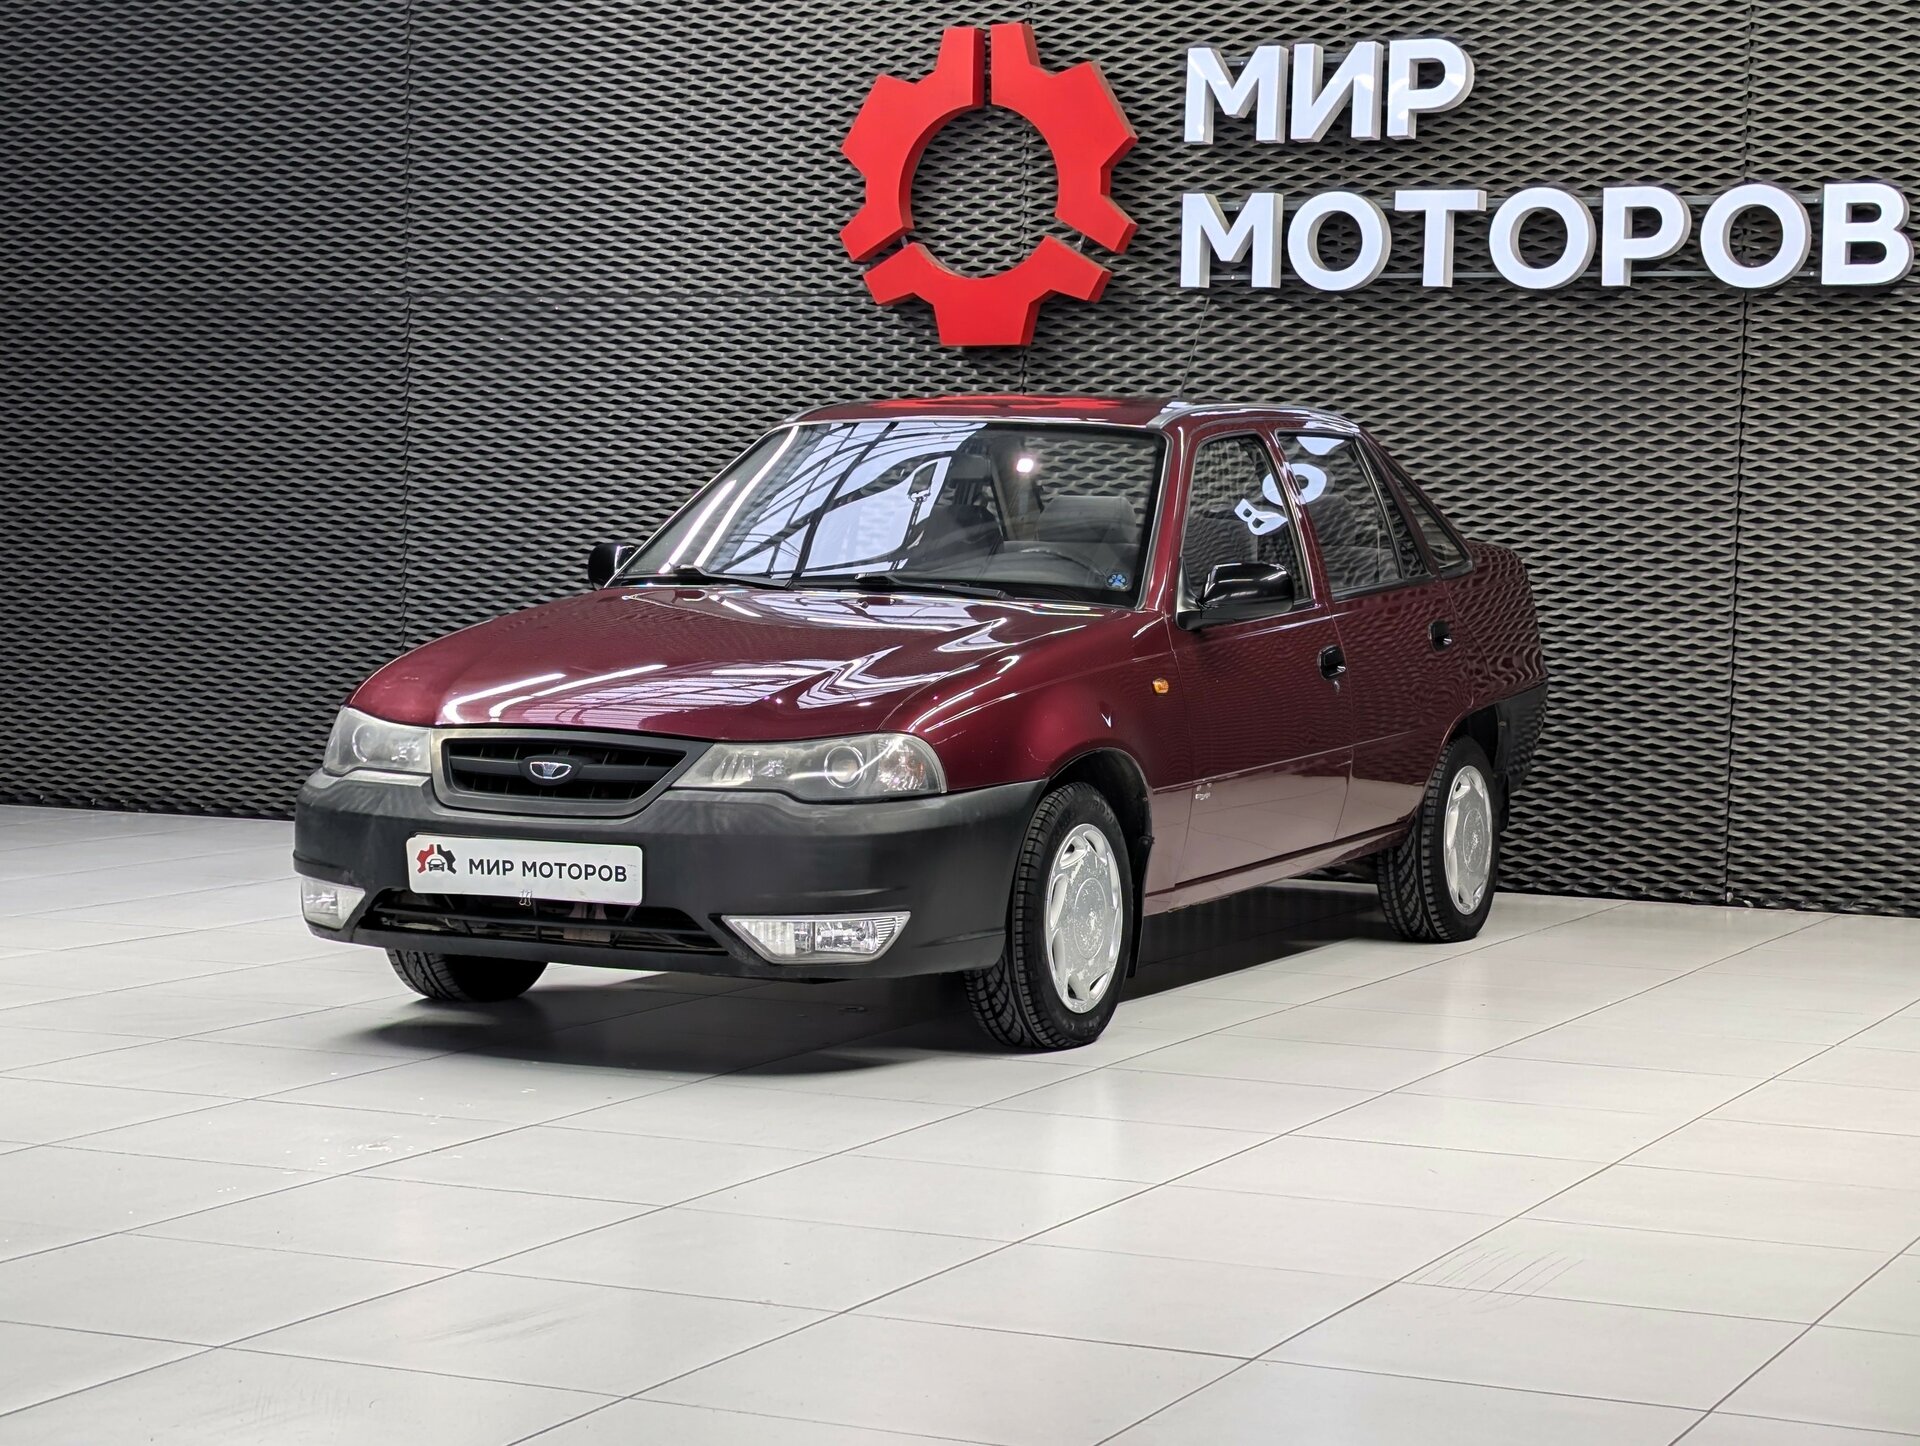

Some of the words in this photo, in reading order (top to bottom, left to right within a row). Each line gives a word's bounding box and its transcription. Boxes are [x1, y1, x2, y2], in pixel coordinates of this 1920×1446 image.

[1184, 38, 1475, 145] МИР
[1179, 182, 1914, 292] МОТОРОВ
[468, 858, 515, 876] МИР
[521, 861, 628, 883] МОТОРОВ
